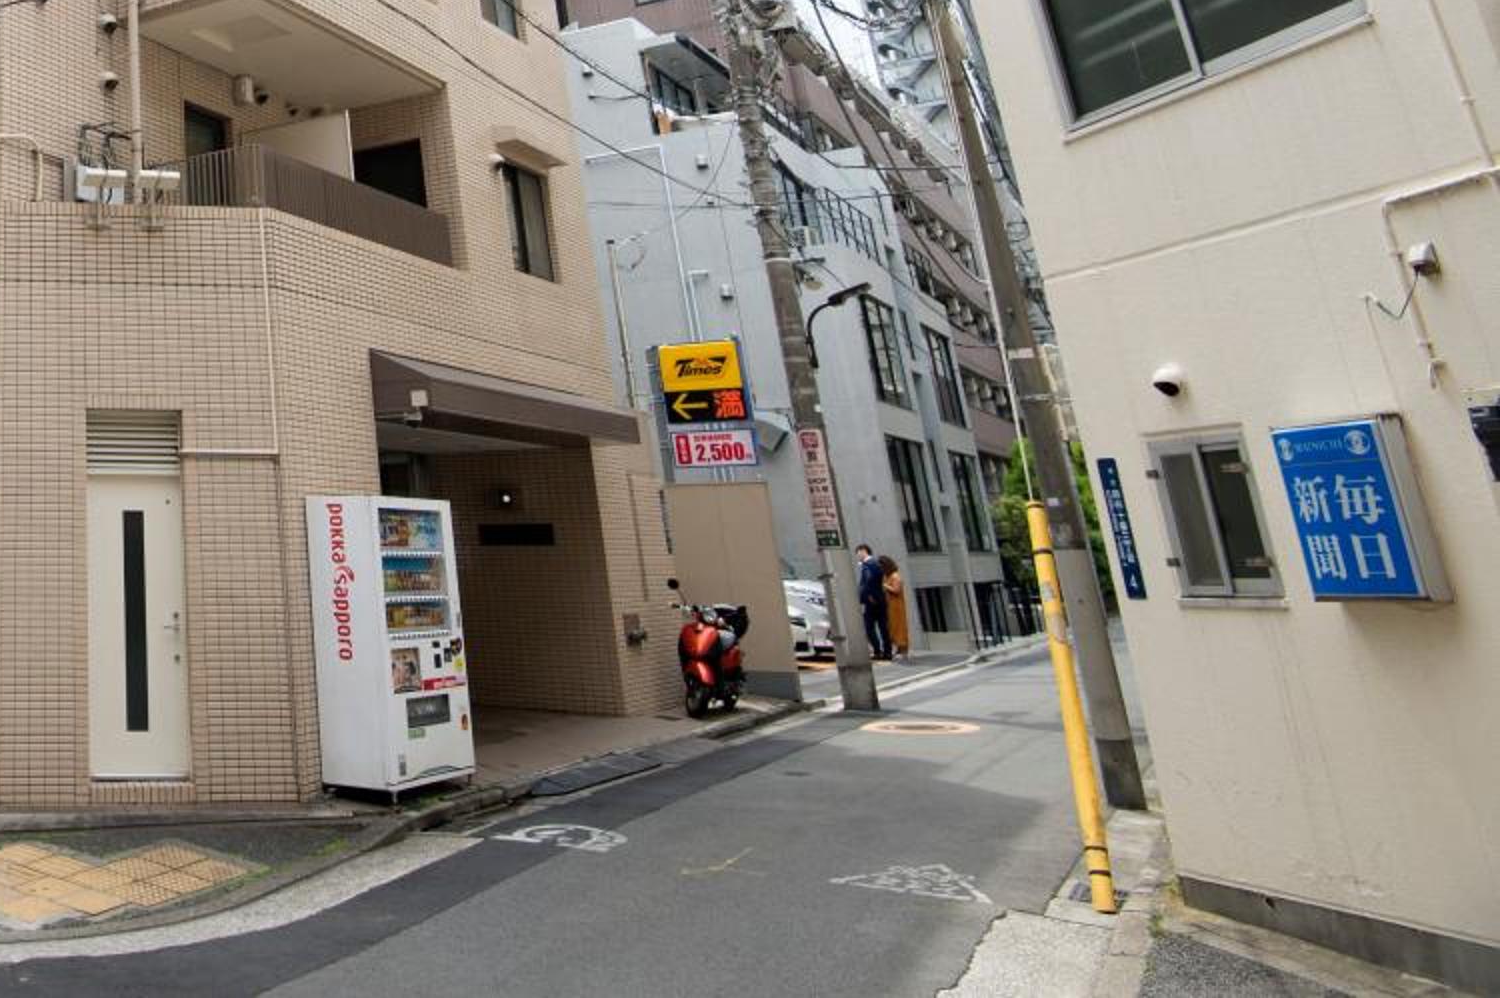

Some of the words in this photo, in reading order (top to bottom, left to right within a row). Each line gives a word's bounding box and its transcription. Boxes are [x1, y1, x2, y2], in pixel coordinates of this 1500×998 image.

[675, 356, 726, 378] Times
[1293, 477, 1348, 580] 新聞
[1334, 474, 1397, 580] 毎日
[333, 572, 354, 661] sapporo
